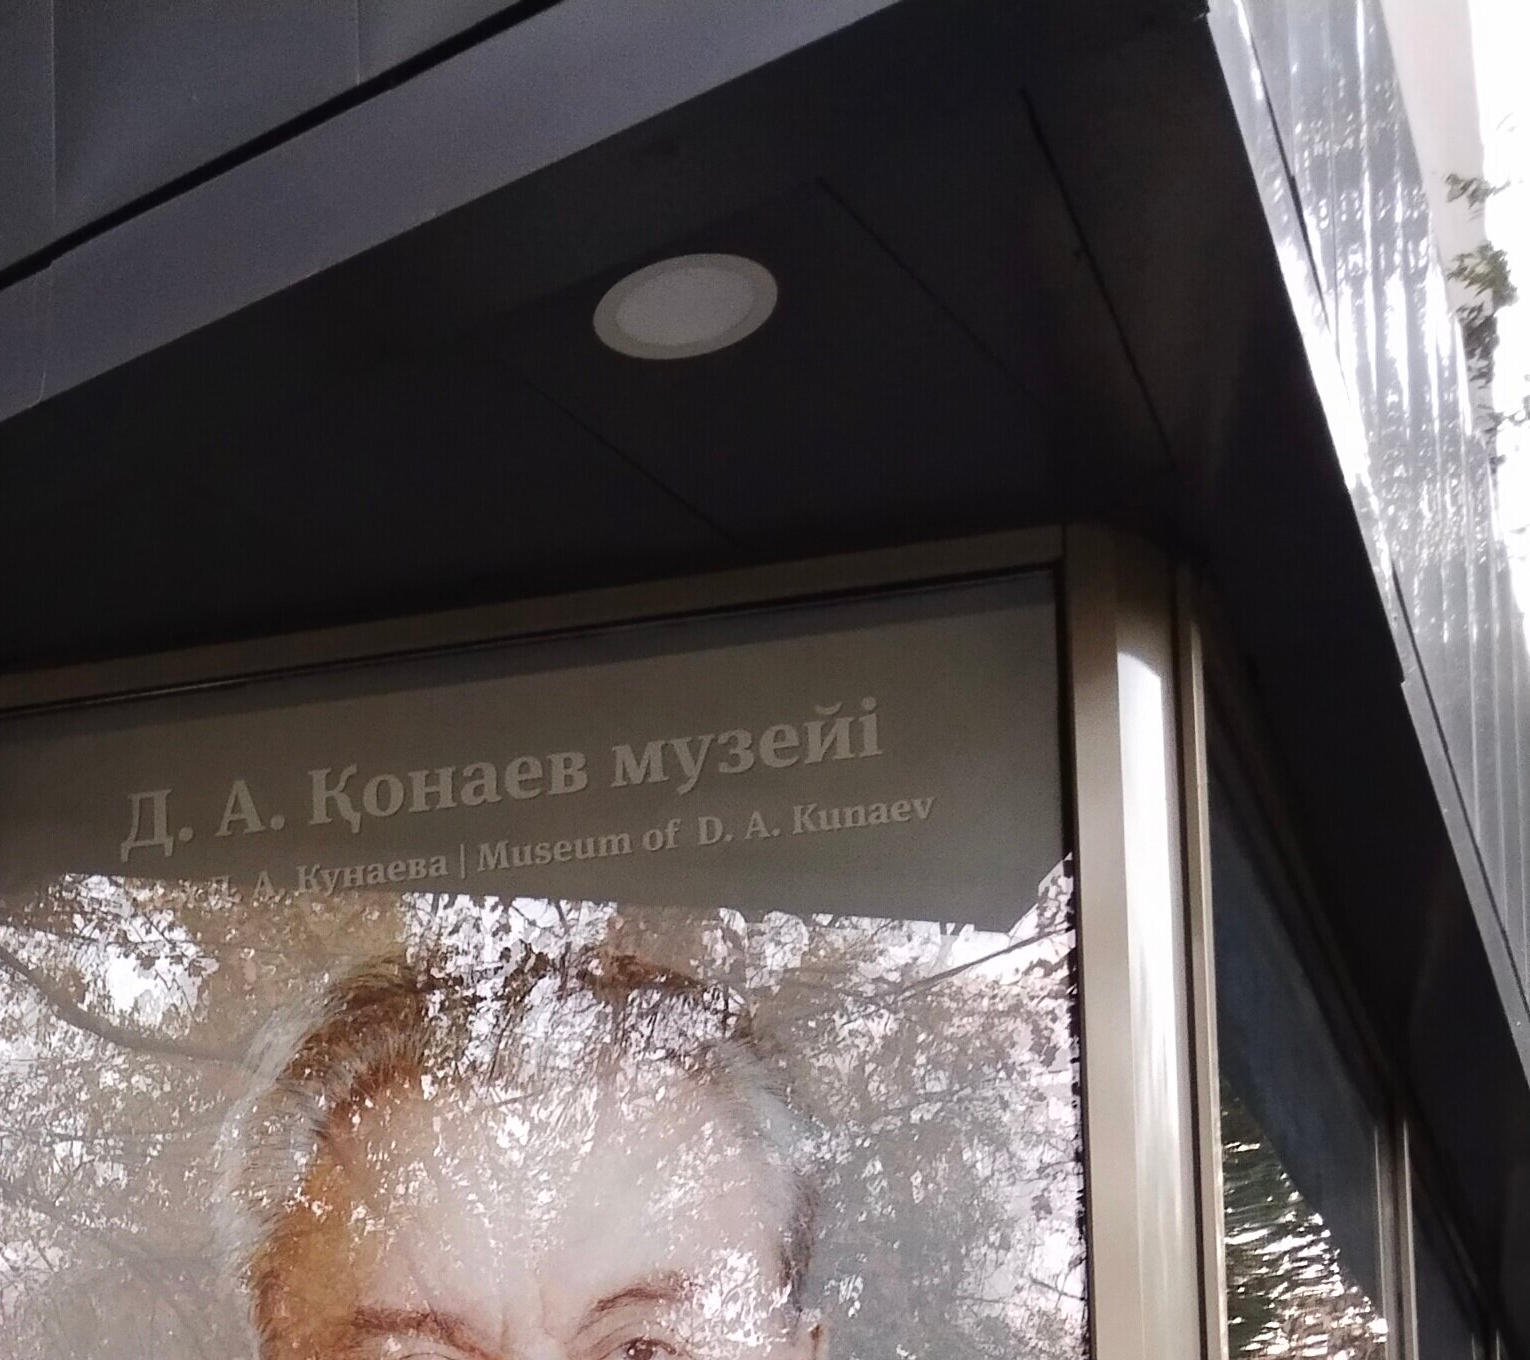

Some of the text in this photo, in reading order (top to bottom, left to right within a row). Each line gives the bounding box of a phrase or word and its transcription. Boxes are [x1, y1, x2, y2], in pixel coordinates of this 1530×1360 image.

[121, 696, 885, 863] Д. А. Қонаев музейі
[476, 795, 936, 872] Museum of D. A. Kunaev
[296, 854, 449, 897] Кунаева
